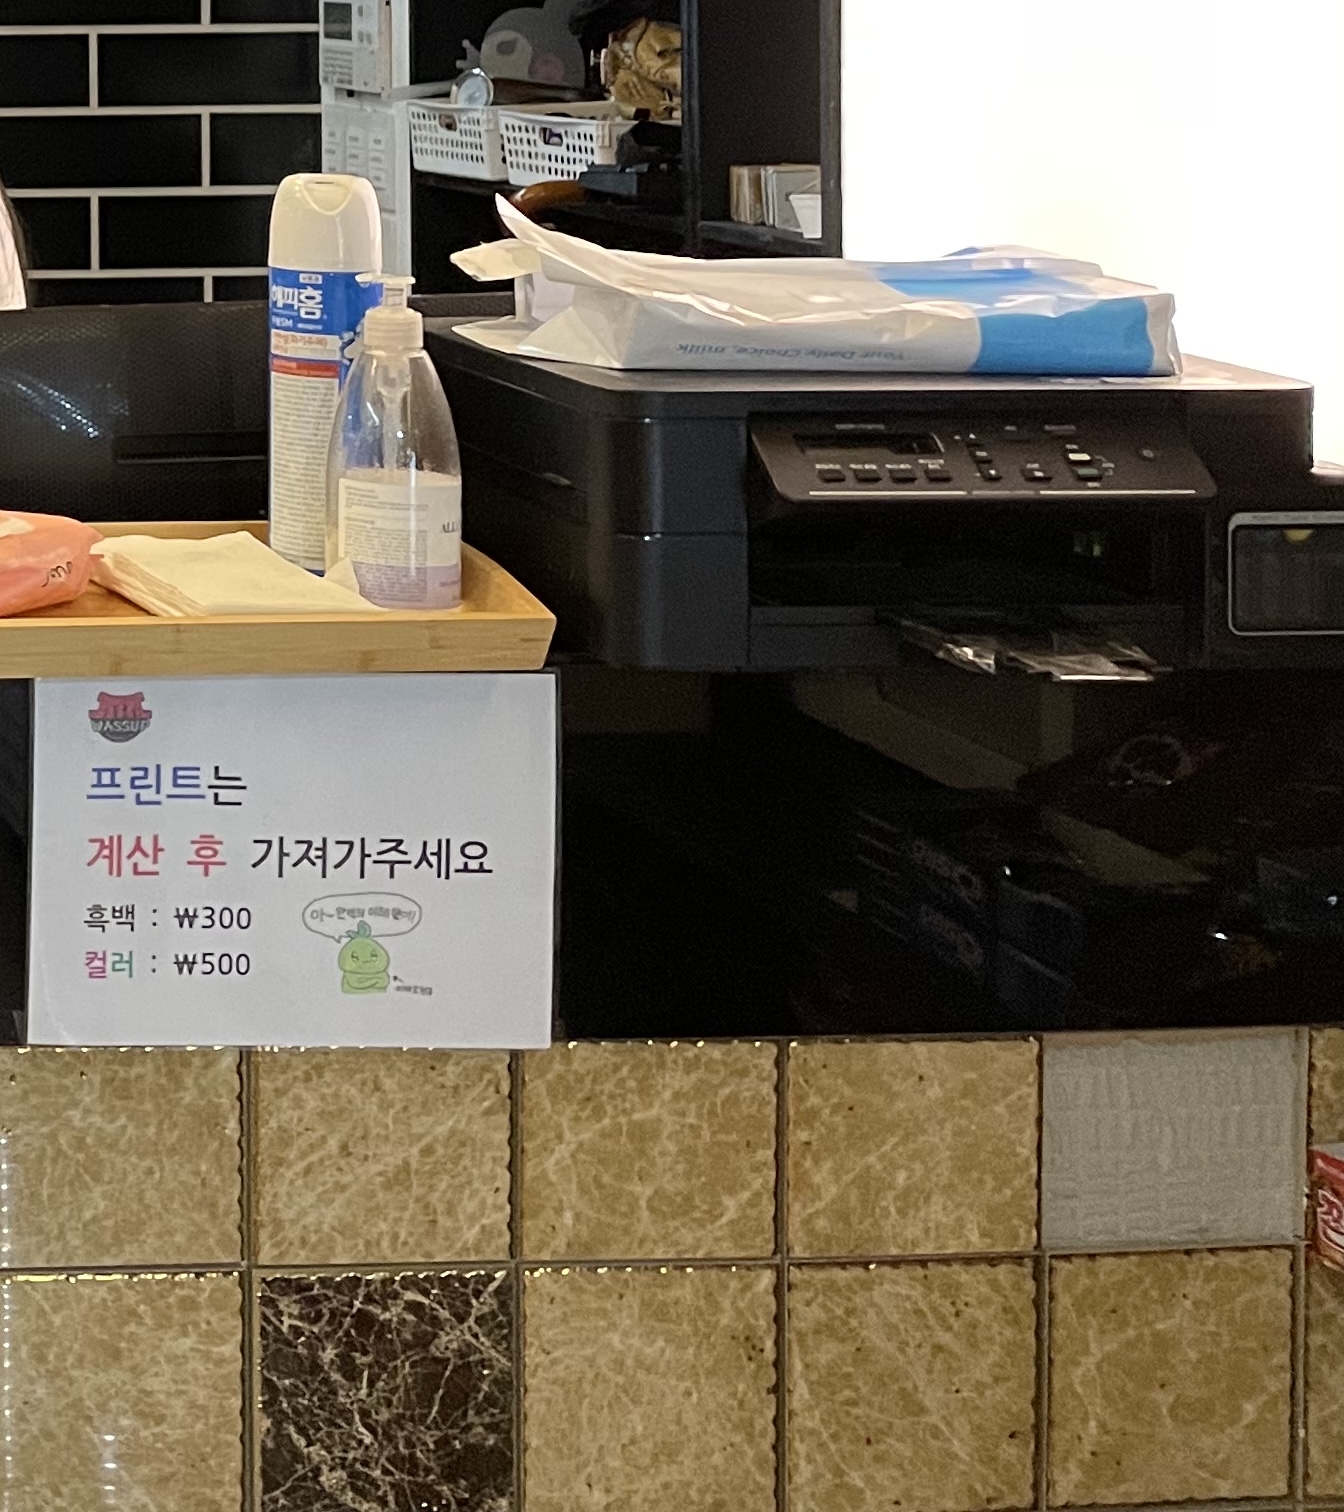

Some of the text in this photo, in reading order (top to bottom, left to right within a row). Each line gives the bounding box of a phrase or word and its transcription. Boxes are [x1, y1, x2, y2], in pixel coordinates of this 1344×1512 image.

[806, 349, 856, 360] Daily
[86, 763, 248, 806] 프린트는
[86, 834, 494, 881] 계산 후 가져가주세요
[83, 903, 136, 933] 흑백
[173, 906, 252, 930] ₩300
[84, 950, 135, 979] 컬러
[173, 952, 252, 976] ₩500
